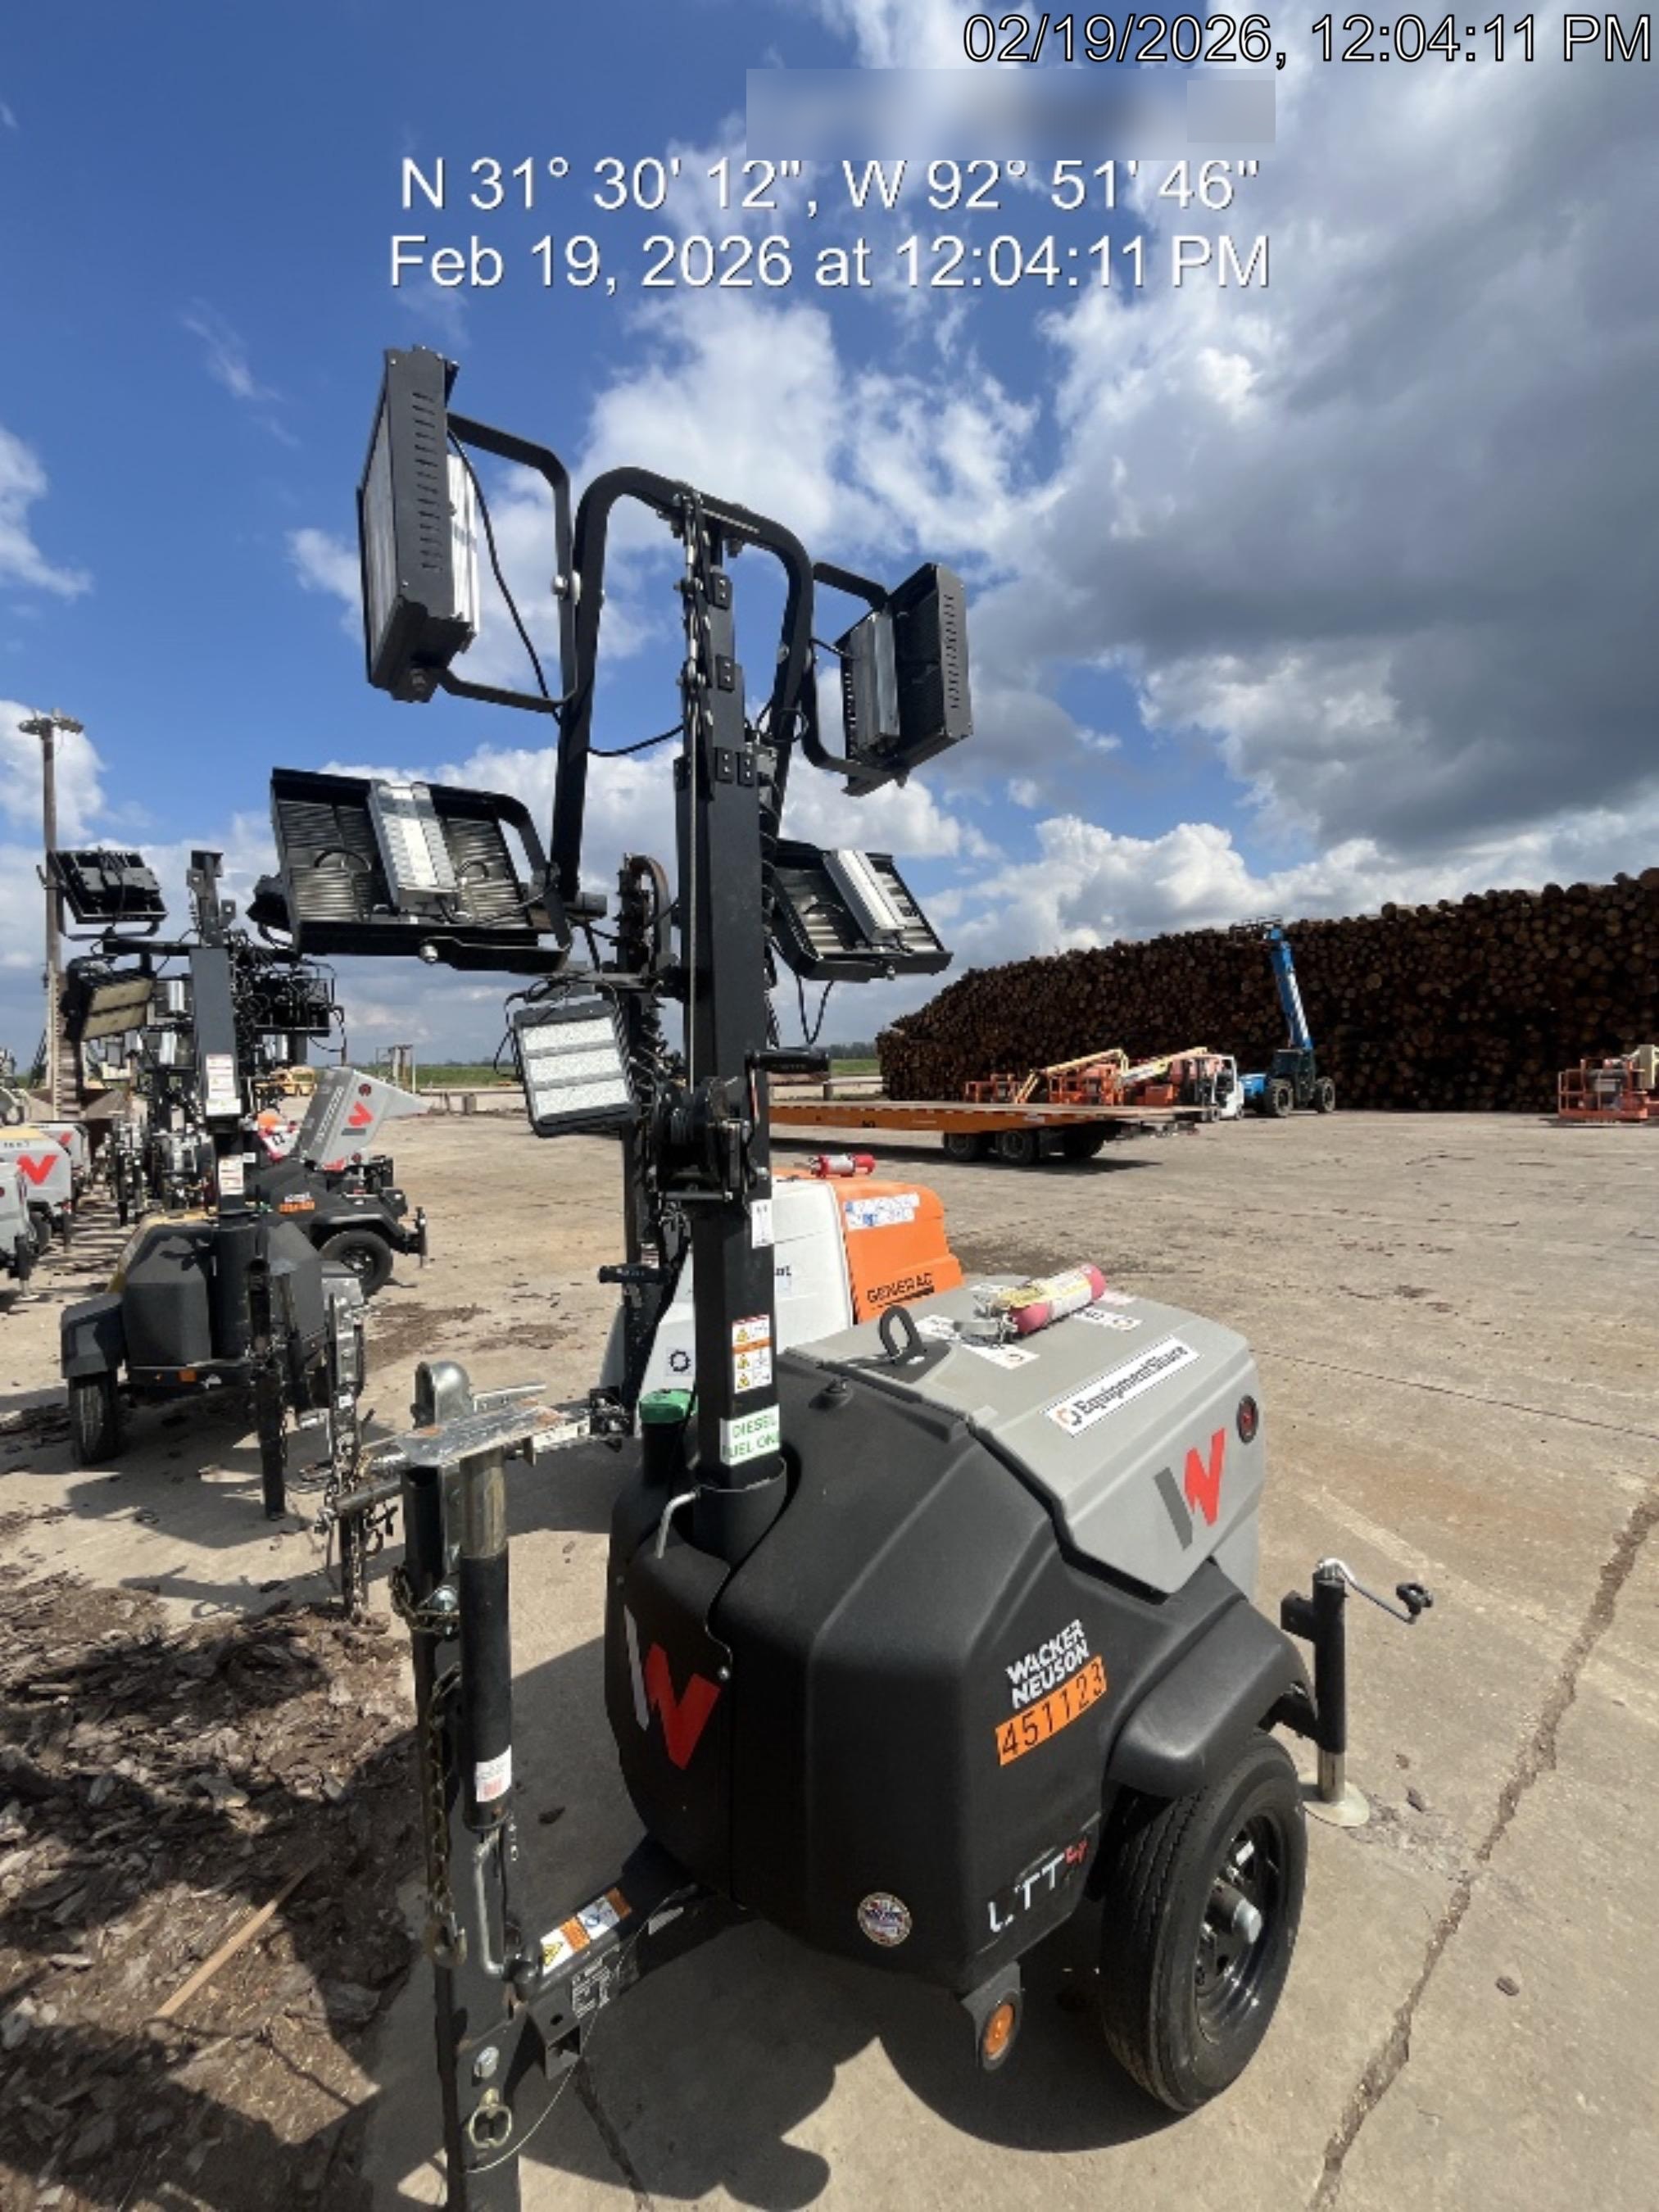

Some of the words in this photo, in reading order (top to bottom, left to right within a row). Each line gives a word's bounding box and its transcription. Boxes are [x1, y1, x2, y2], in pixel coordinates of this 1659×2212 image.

[867, 1273, 933, 1303] GENERAC
[1074, 1345, 1189, 1416] EquipmentShare
[1004, 1619, 1085, 1684] WACKER
[1011, 1639, 1090, 1709] NEUSON
[1002, 1661, 1103, 1756] 451123
